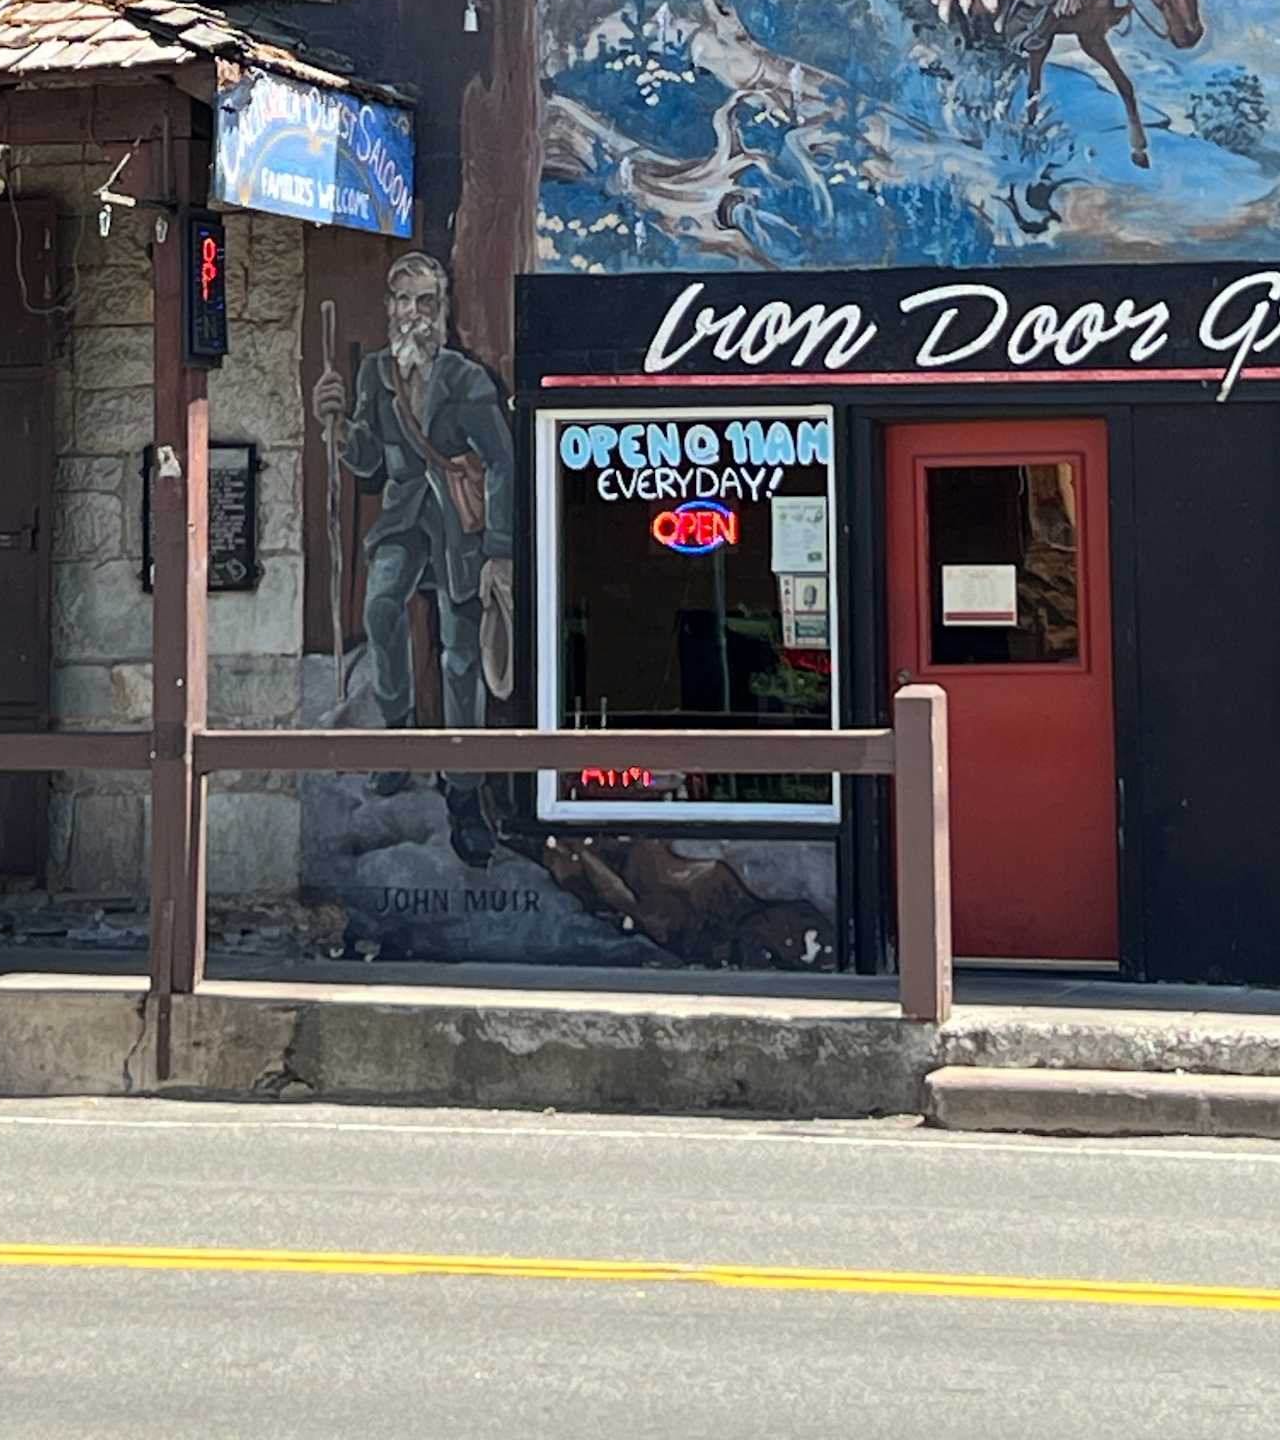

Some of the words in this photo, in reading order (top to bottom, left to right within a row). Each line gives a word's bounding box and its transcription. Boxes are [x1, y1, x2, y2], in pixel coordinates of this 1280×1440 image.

[644, 282, 877, 373] Iron
[900, 283, 1172, 370] Door
[560, 420, 682, 471] OPEN
[723, 419, 829, 466] 11AM
[597, 466, 784, 502] EVERYDAY!
[652, 510, 738, 546] OPEN
[376, 886, 449, 914] JOHN
[464, 888, 542, 913] MUIR
